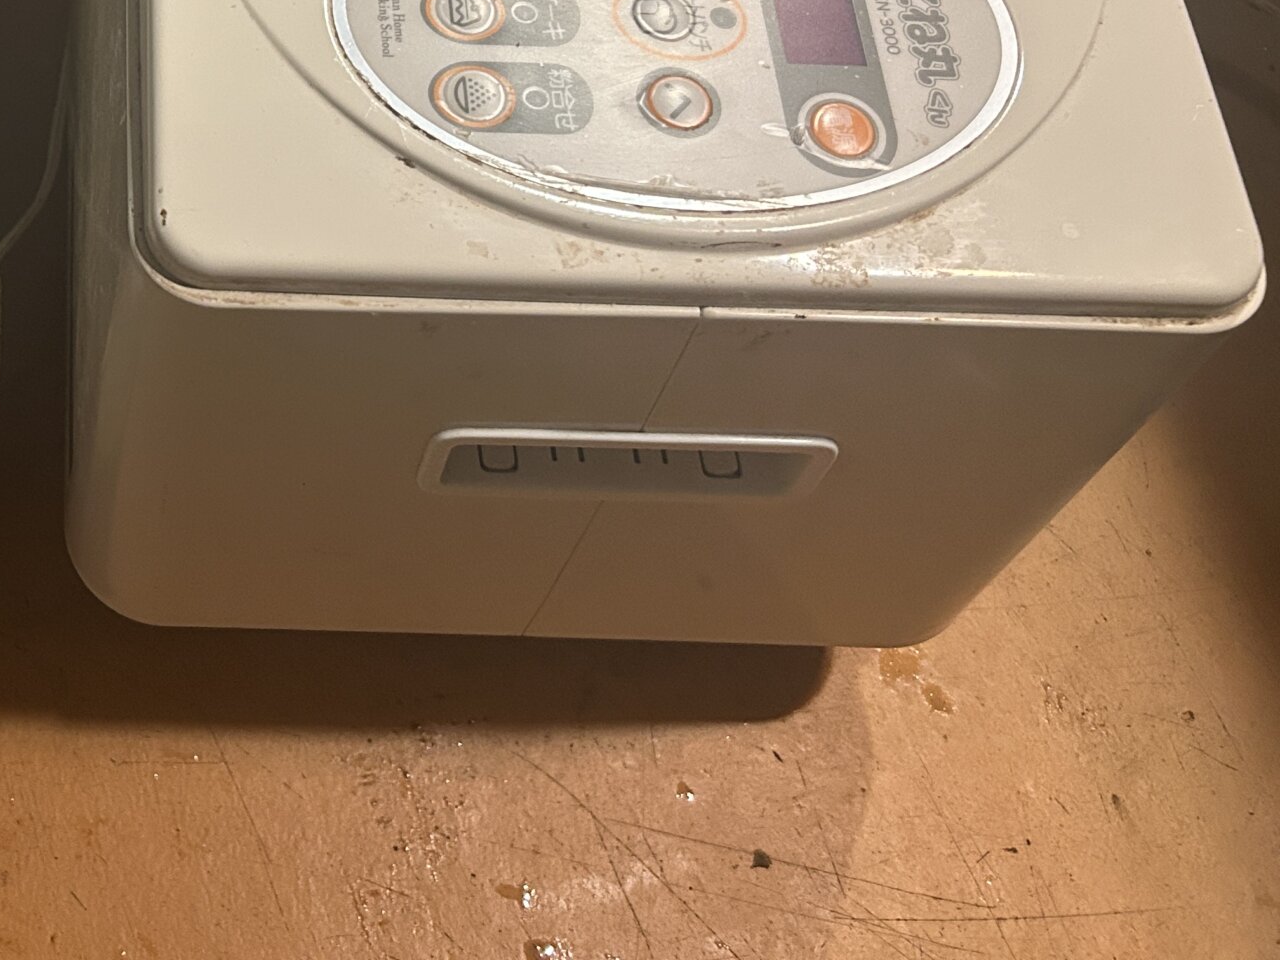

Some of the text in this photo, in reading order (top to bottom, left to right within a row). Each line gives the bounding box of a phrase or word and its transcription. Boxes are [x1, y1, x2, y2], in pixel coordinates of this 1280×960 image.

[380, 23, 394, 58] School
[393, 14, 405, 43] Home
[547, 68, 579, 131] 粉合せ
